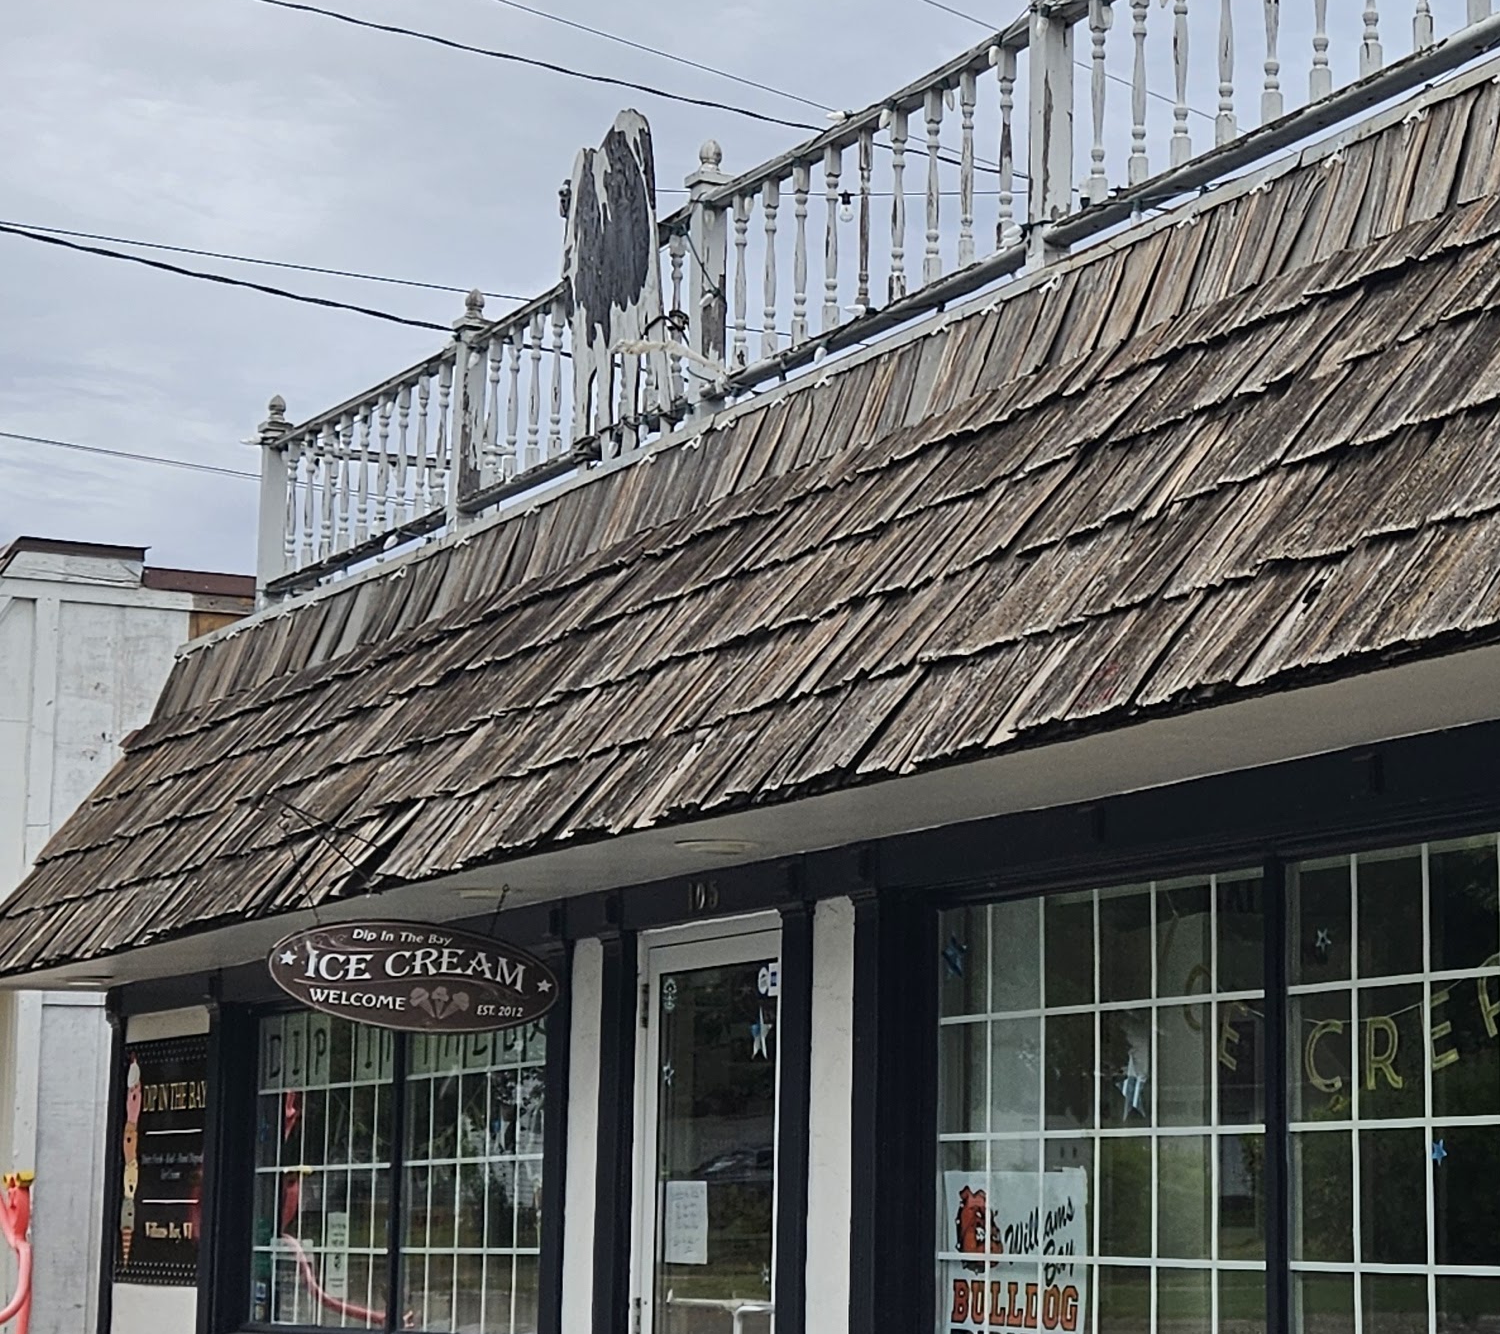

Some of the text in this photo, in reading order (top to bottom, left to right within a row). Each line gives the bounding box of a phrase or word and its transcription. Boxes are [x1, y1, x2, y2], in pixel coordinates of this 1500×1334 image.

[687, 877, 720, 913] 105
[352, 928, 453, 946] Dip In The Bay
[304, 940, 527, 994] ICE CREAM
[309, 987, 407, 1011] WELCOME
[476, 1005, 524, 1017] EST. 2012
[1004, 1195, 1075, 1265] Willams
[951, 1279, 1079, 1333] BULLDOG
